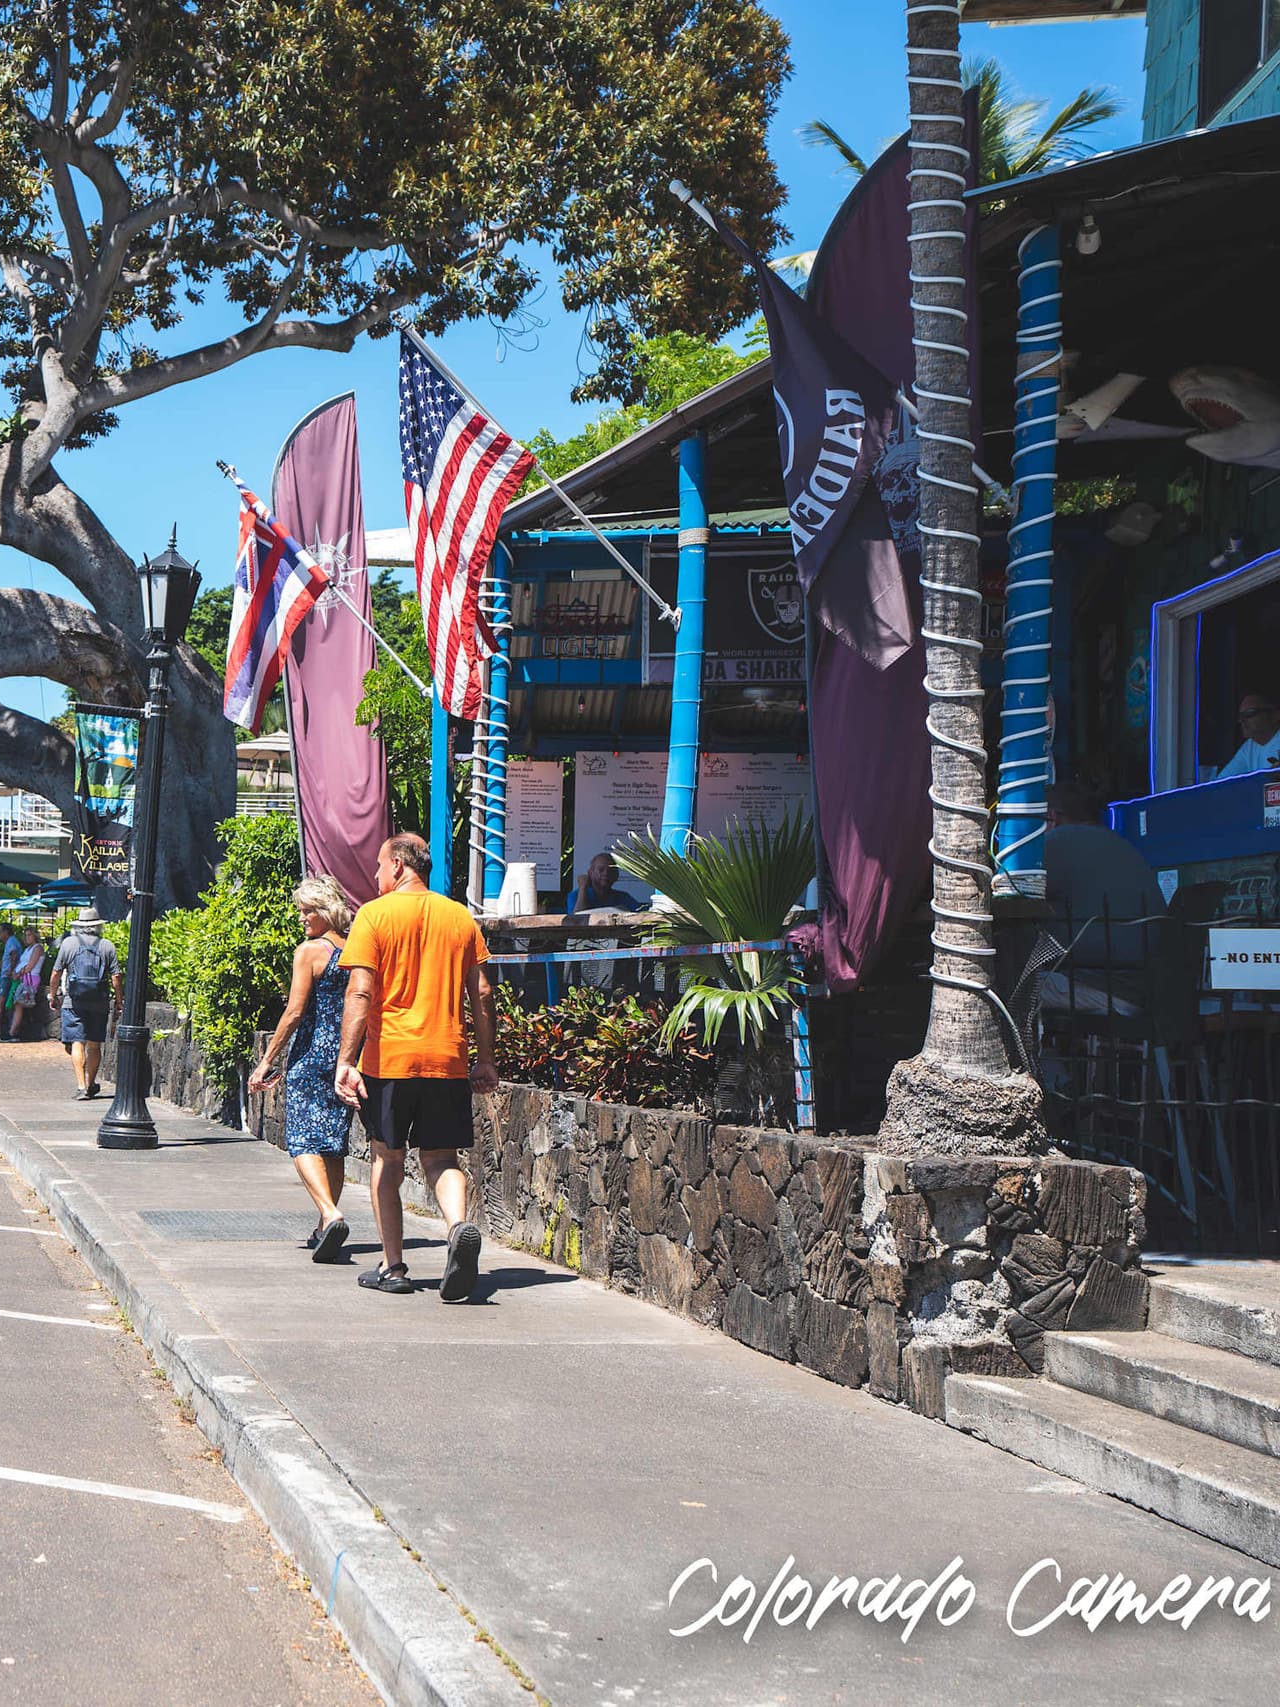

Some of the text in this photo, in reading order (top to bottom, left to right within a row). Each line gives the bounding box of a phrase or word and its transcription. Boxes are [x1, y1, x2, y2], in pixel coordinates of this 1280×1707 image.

[758, 573, 800, 584] RAID
[541, 634, 618, 658] LIGHT
[735, 660, 802, 681] SHARK
